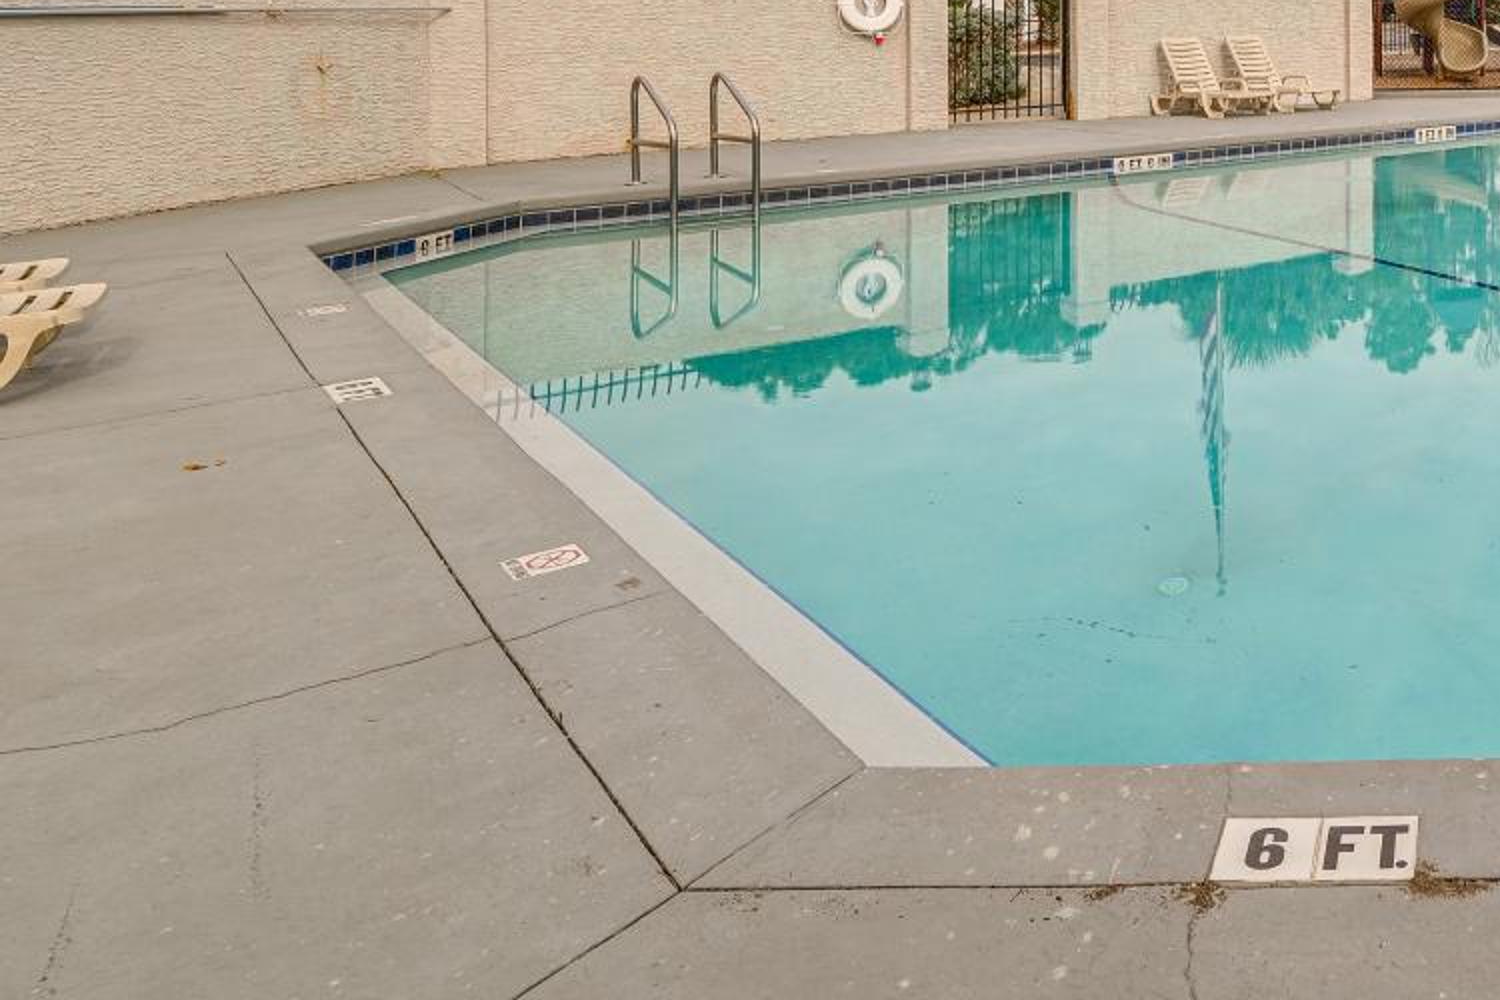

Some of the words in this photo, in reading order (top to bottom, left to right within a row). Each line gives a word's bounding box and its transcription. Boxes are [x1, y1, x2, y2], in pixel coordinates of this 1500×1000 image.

[1129, 158, 1143, 170] FT
[435, 233, 453, 254] FT
[1245, 826, 1289, 870] 6
[1321, 824, 1410, 870] FT.
